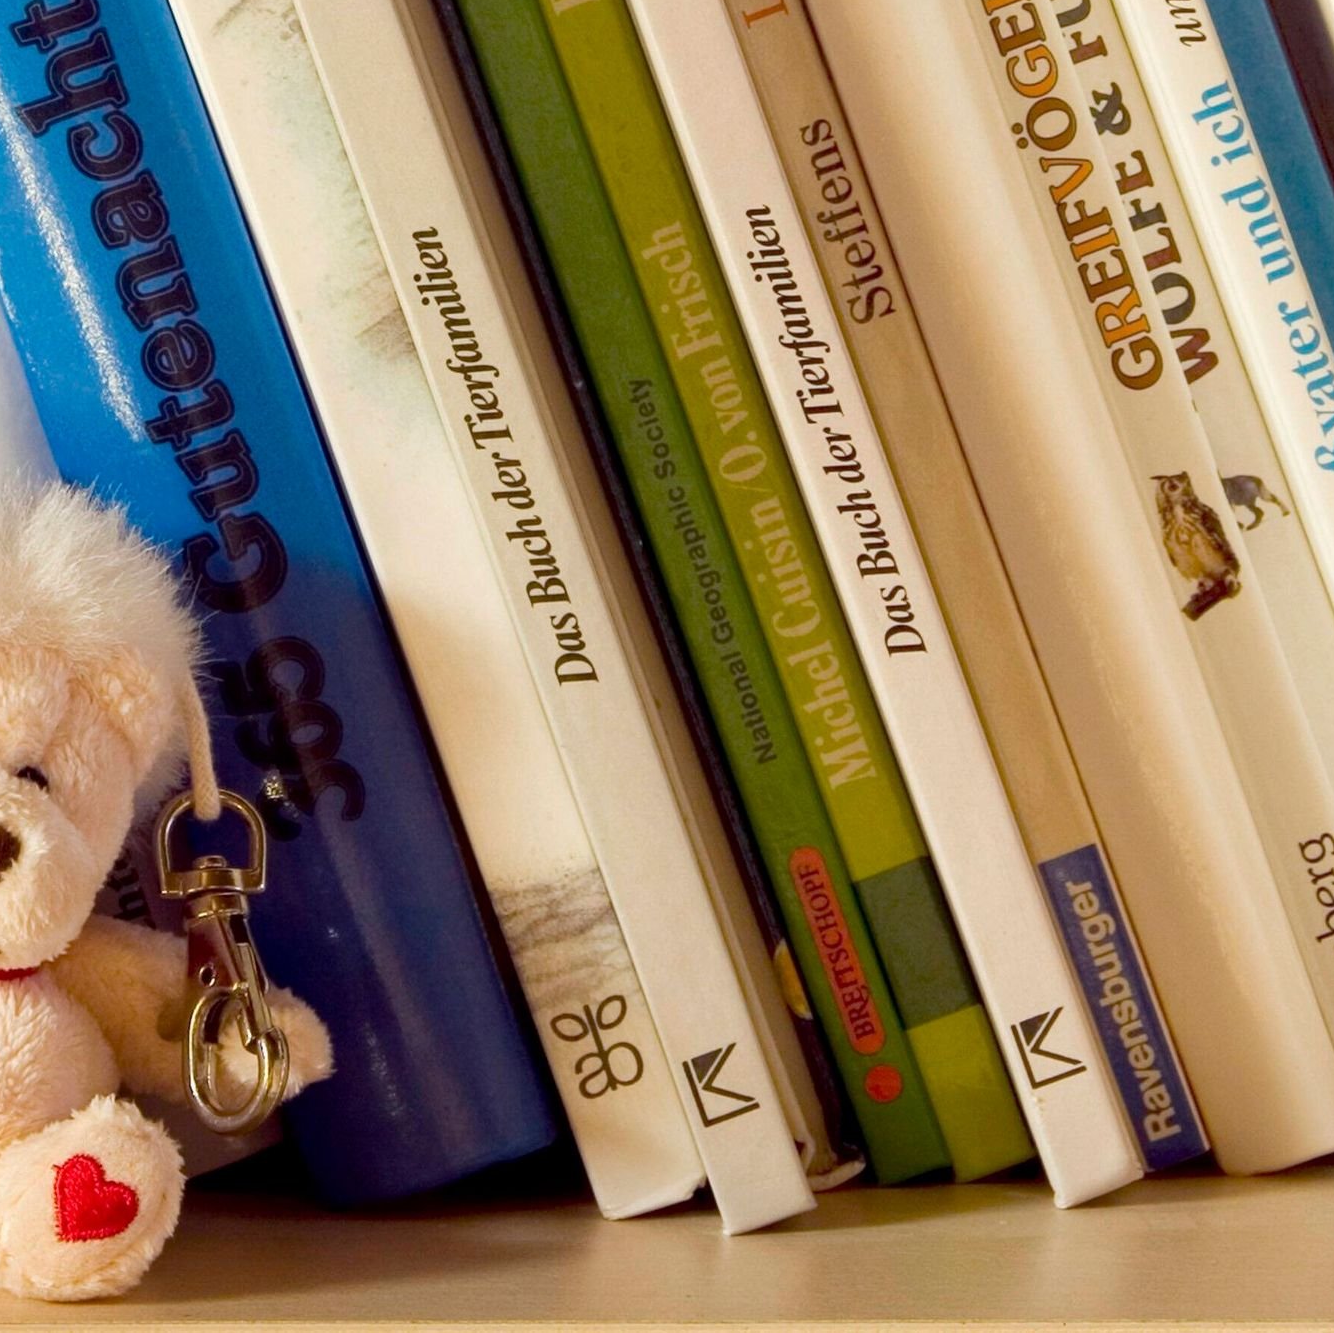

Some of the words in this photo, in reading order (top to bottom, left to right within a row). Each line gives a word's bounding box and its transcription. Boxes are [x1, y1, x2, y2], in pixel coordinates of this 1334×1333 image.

[1091, 81, 1133, 136] &
[1192, 79, 1255, 168] ich
[799, 117, 896, 325] Steffens
[1221, 178, 1293, 283] und
[410, 224, 515, 452] Tierfamilien
[642, 220, 725, 360] Frisch
[745, 204, 843, 425] Tierfamilien
[629, 376, 679, 482] Society
[701, 367, 749, 439] von
[490, 453, 537, 513] der
[822, 427, 868, 493] der
[506, 512, 571, 608] Buch
[665, 485, 736, 644] Geographic
[836, 488, 899, 580] Buch
[554, 609, 600, 688] Das
[882, 584, 928, 658] Das
[237, 633, 367, 843] 365
[716, 645, 778, 766] National
[788, 639, 877, 793] Michel
[799, 864, 876, 1040] BREITSCHOPF
[1066, 878, 1180, 1142] Ravensburger
